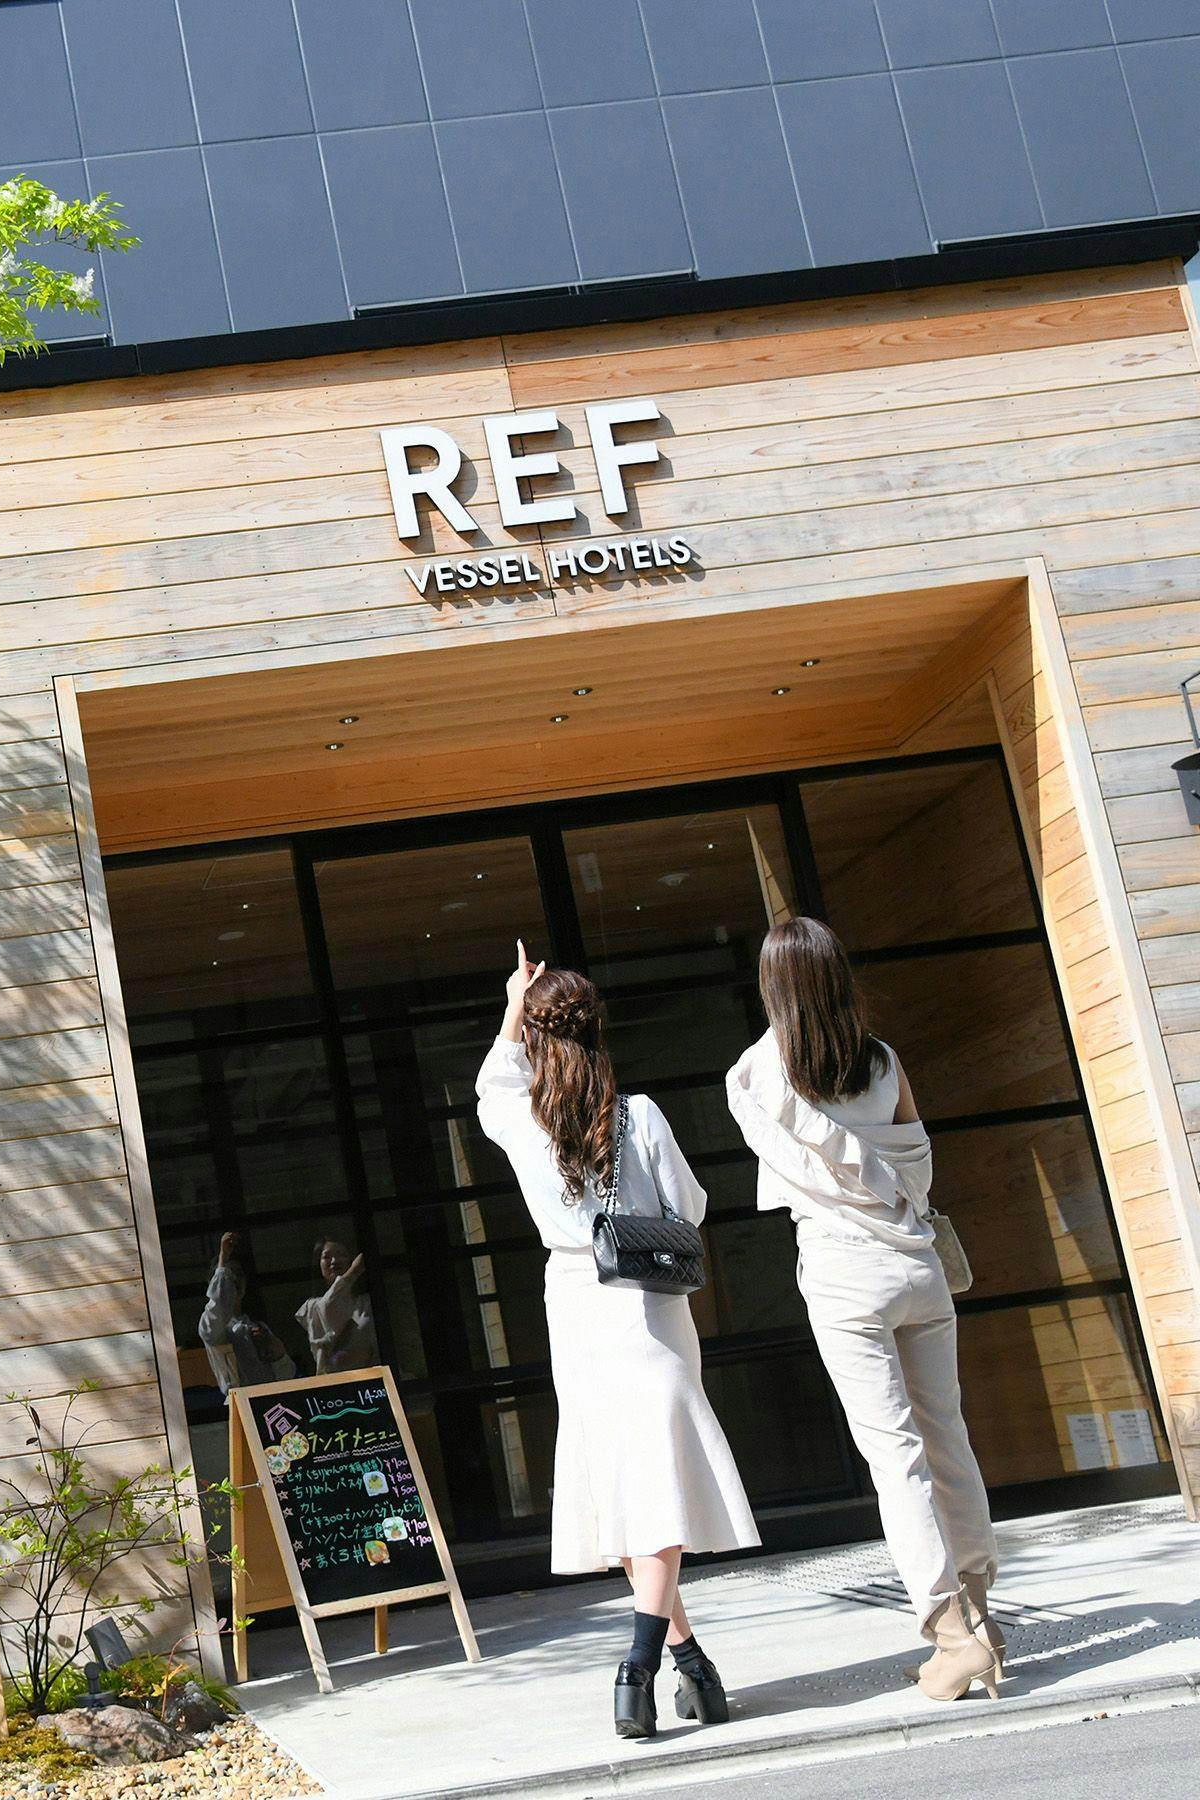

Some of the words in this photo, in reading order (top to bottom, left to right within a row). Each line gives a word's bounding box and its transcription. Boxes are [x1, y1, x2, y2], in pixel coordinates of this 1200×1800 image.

[379, 399, 661, 540] REF
[404, 552, 541, 595] VESSEL
[548, 534, 692, 580] HOTELS
